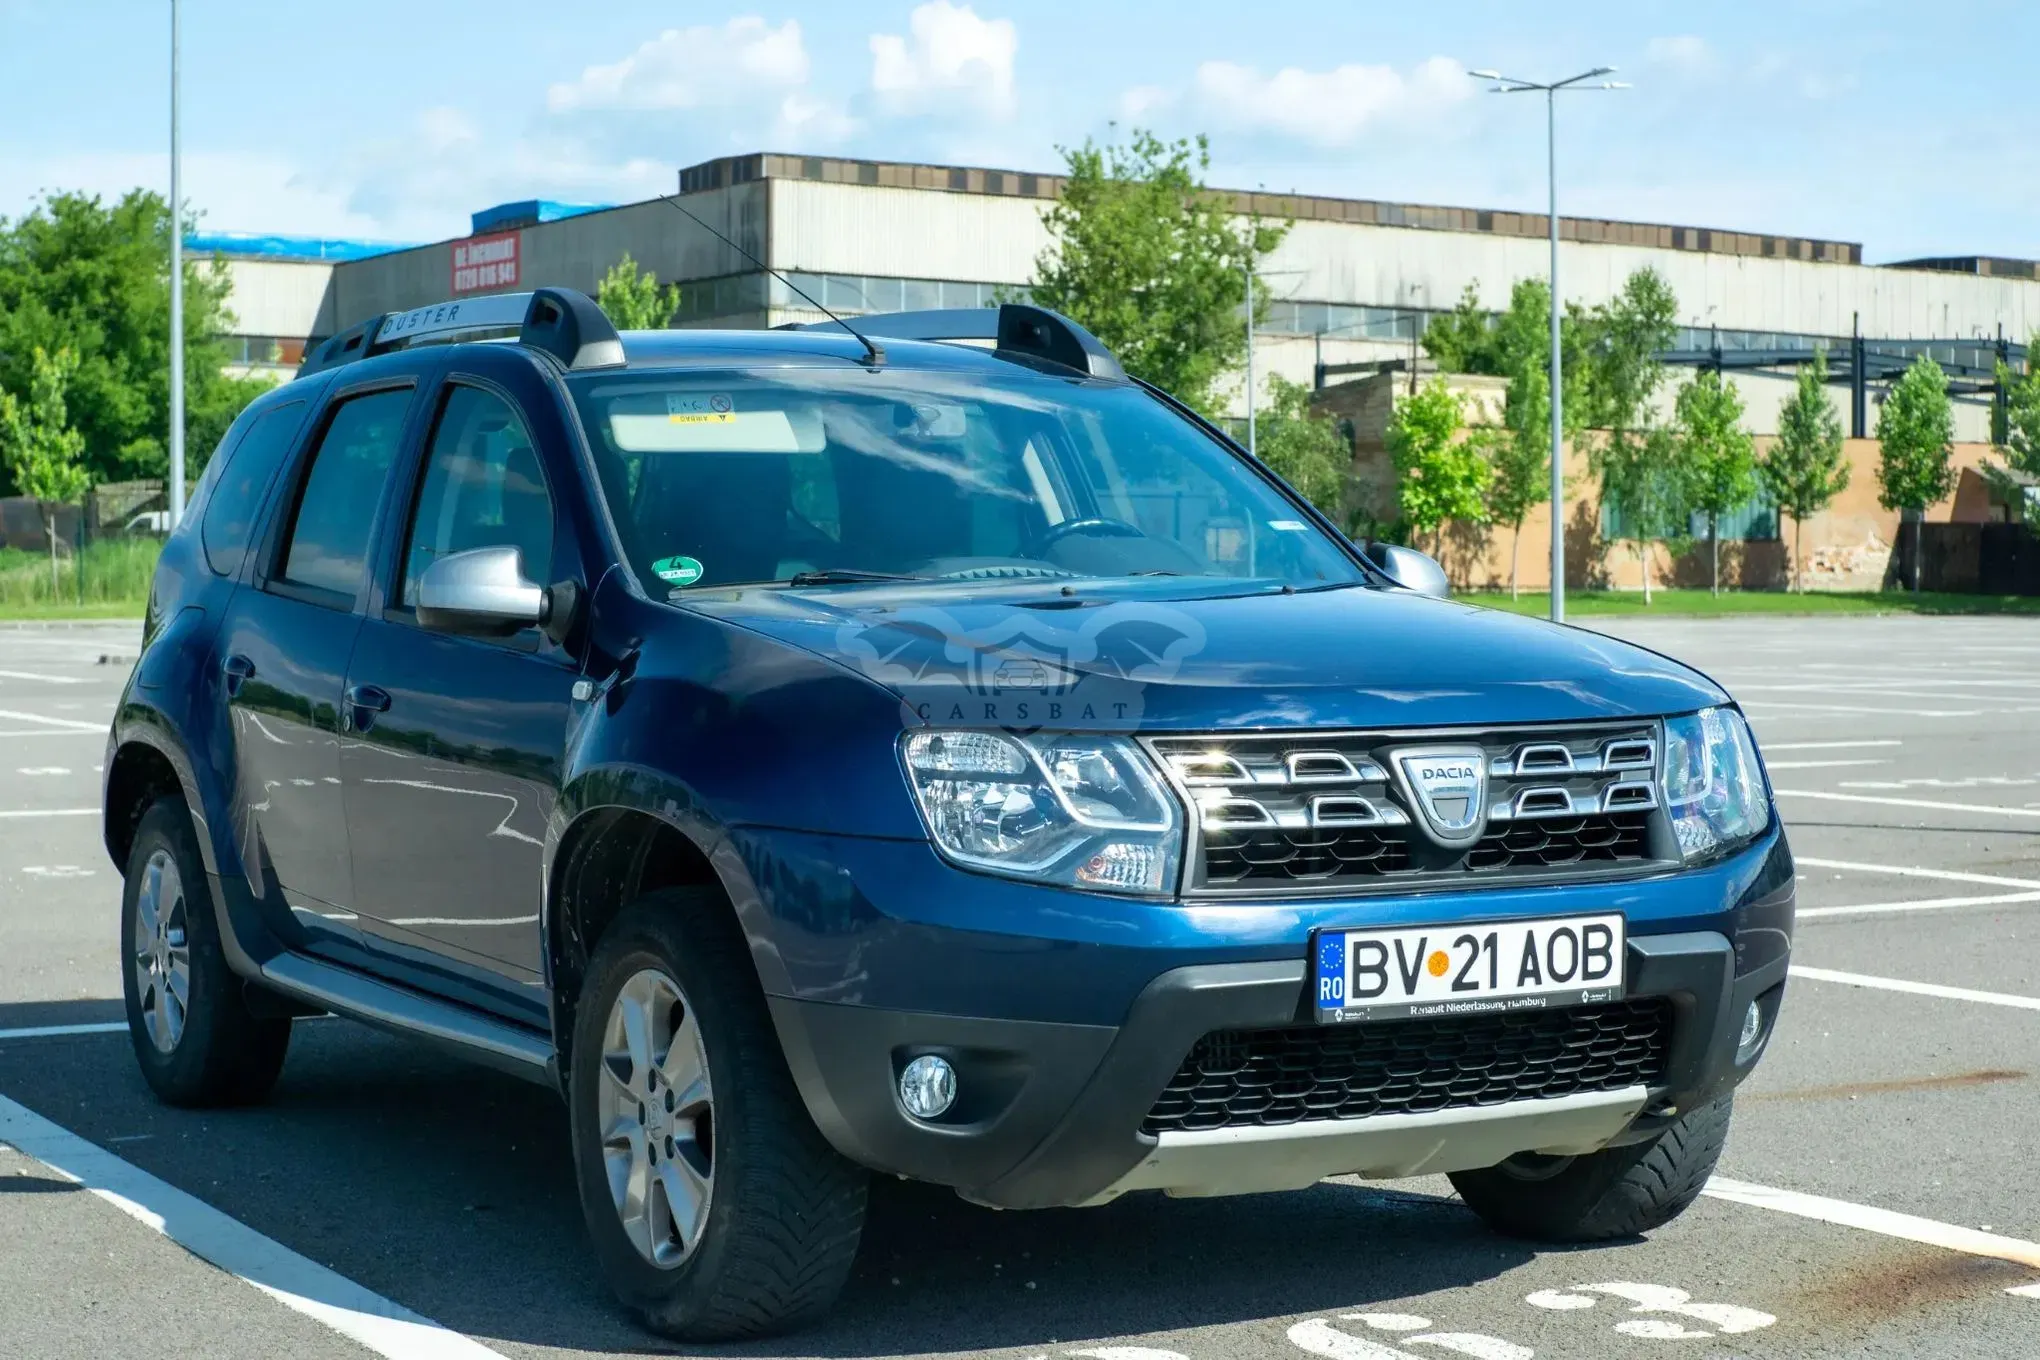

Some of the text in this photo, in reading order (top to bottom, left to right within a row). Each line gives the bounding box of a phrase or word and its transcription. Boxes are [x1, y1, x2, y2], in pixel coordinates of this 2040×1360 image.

[383, 305, 460, 334] DUSTER
[669, 557, 683, 570] 4
[1422, 767, 1475, 779] DACIA
[1320, 923, 1614, 1000] RO BV 21 AOB
